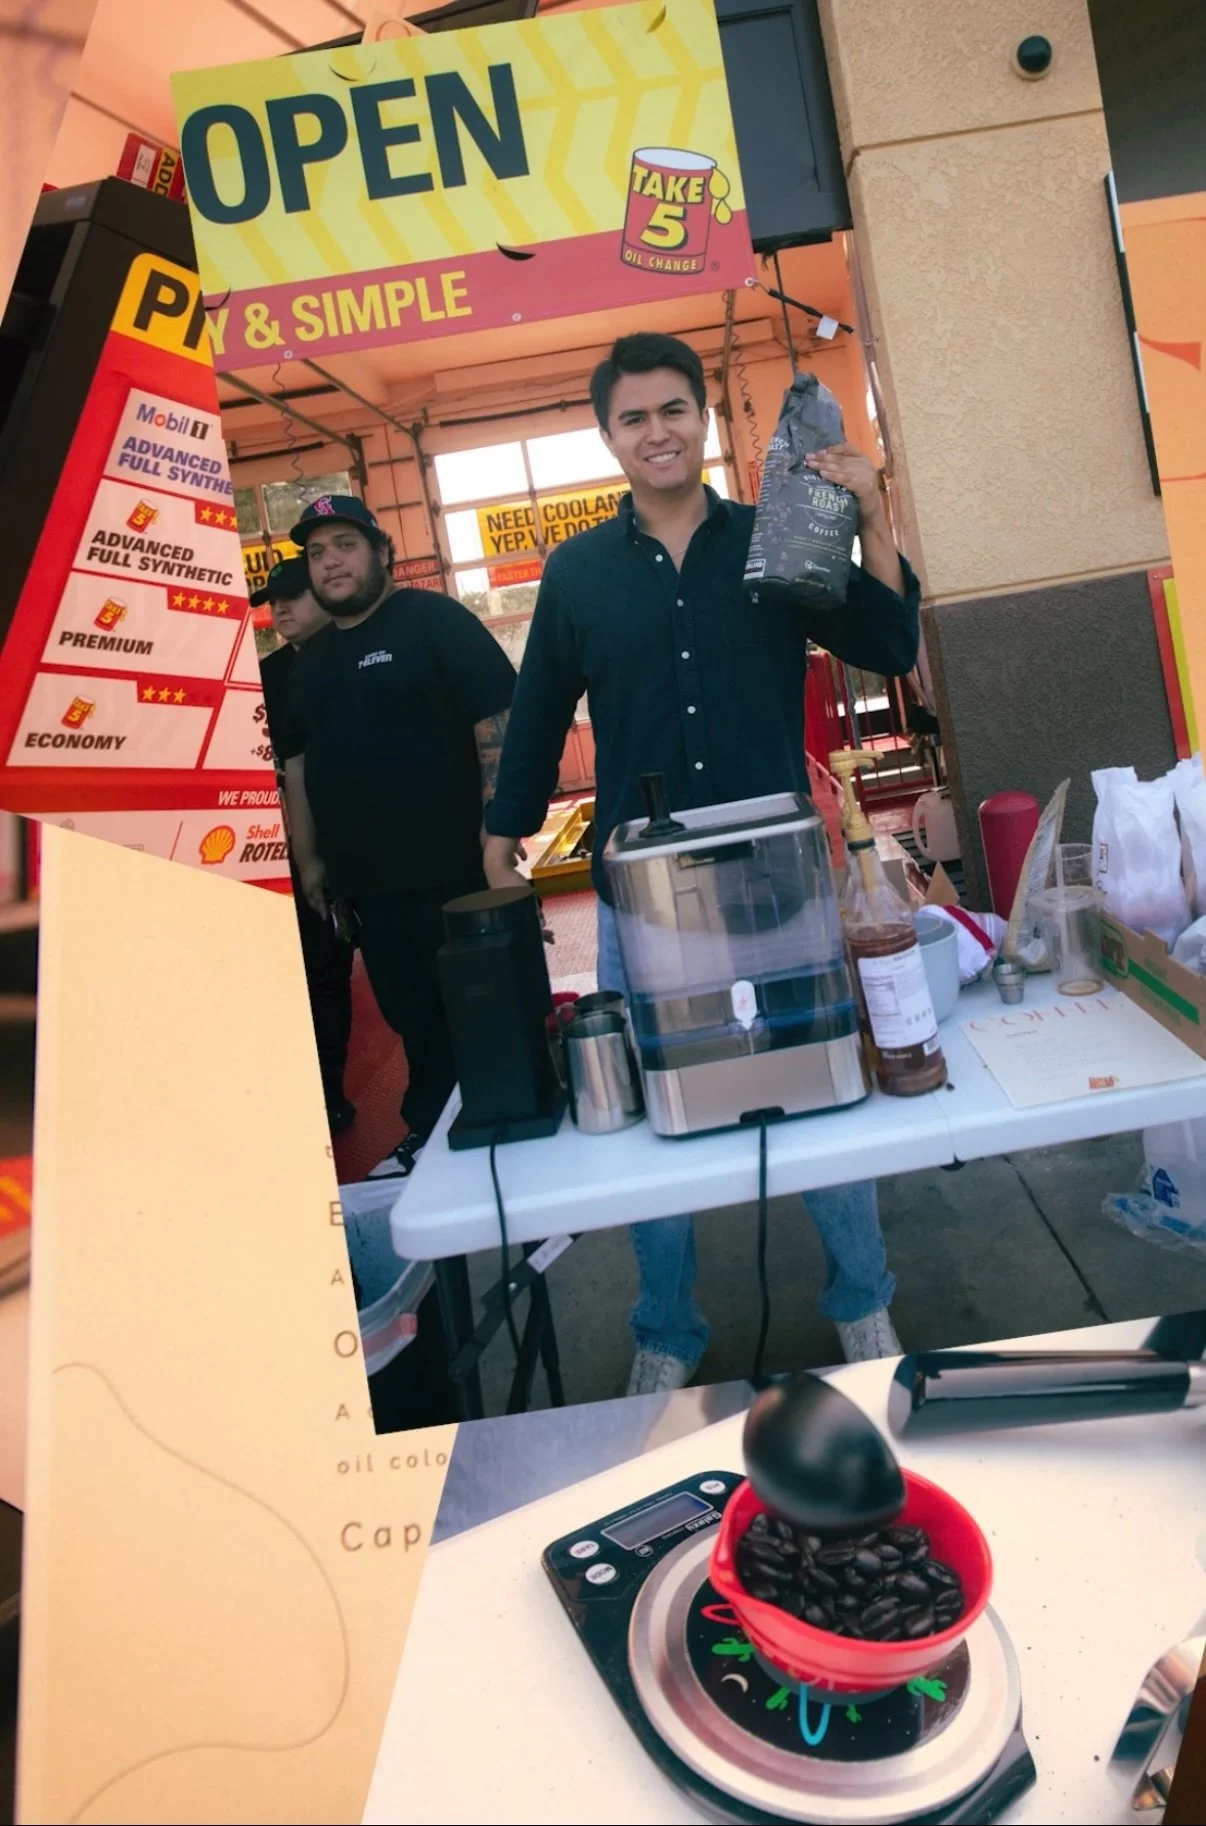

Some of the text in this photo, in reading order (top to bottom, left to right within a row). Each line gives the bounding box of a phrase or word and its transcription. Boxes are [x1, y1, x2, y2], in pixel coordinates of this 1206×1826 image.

[181, 63, 530, 225] OPEN
[632, 164, 706, 205] TAKE
[639, 201, 688, 251] 5
[625, 249, 697, 271] OIL CHANGE
[244, 302, 286, 349] &
[291, 270, 472, 342] SIMPLE
[136, 403, 190, 435] Mobil
[118, 452, 162, 476] FULL
[122, 436, 222, 475] ADVANCED
[811, 498, 846, 514] ROAST
[132, 513, 146, 526] 5
[487, 507, 536, 533] NEED
[92, 530, 195, 562] ADVANCED
[86, 547, 131, 568] FULL
[137, 556, 233, 586] SYNTHETIC
[100, 612, 115, 625] 5
[58, 630, 154, 655] PREMIUM
[67, 710, 82, 723] 5
[24, 732, 127, 750] ECONOMY
[218, 790, 282, 806] WE PROUD
[245, 823, 281, 840] Shell
[336, 1448, 448, 1475] oil colo
[340, 1521, 422, 1553] Cap
